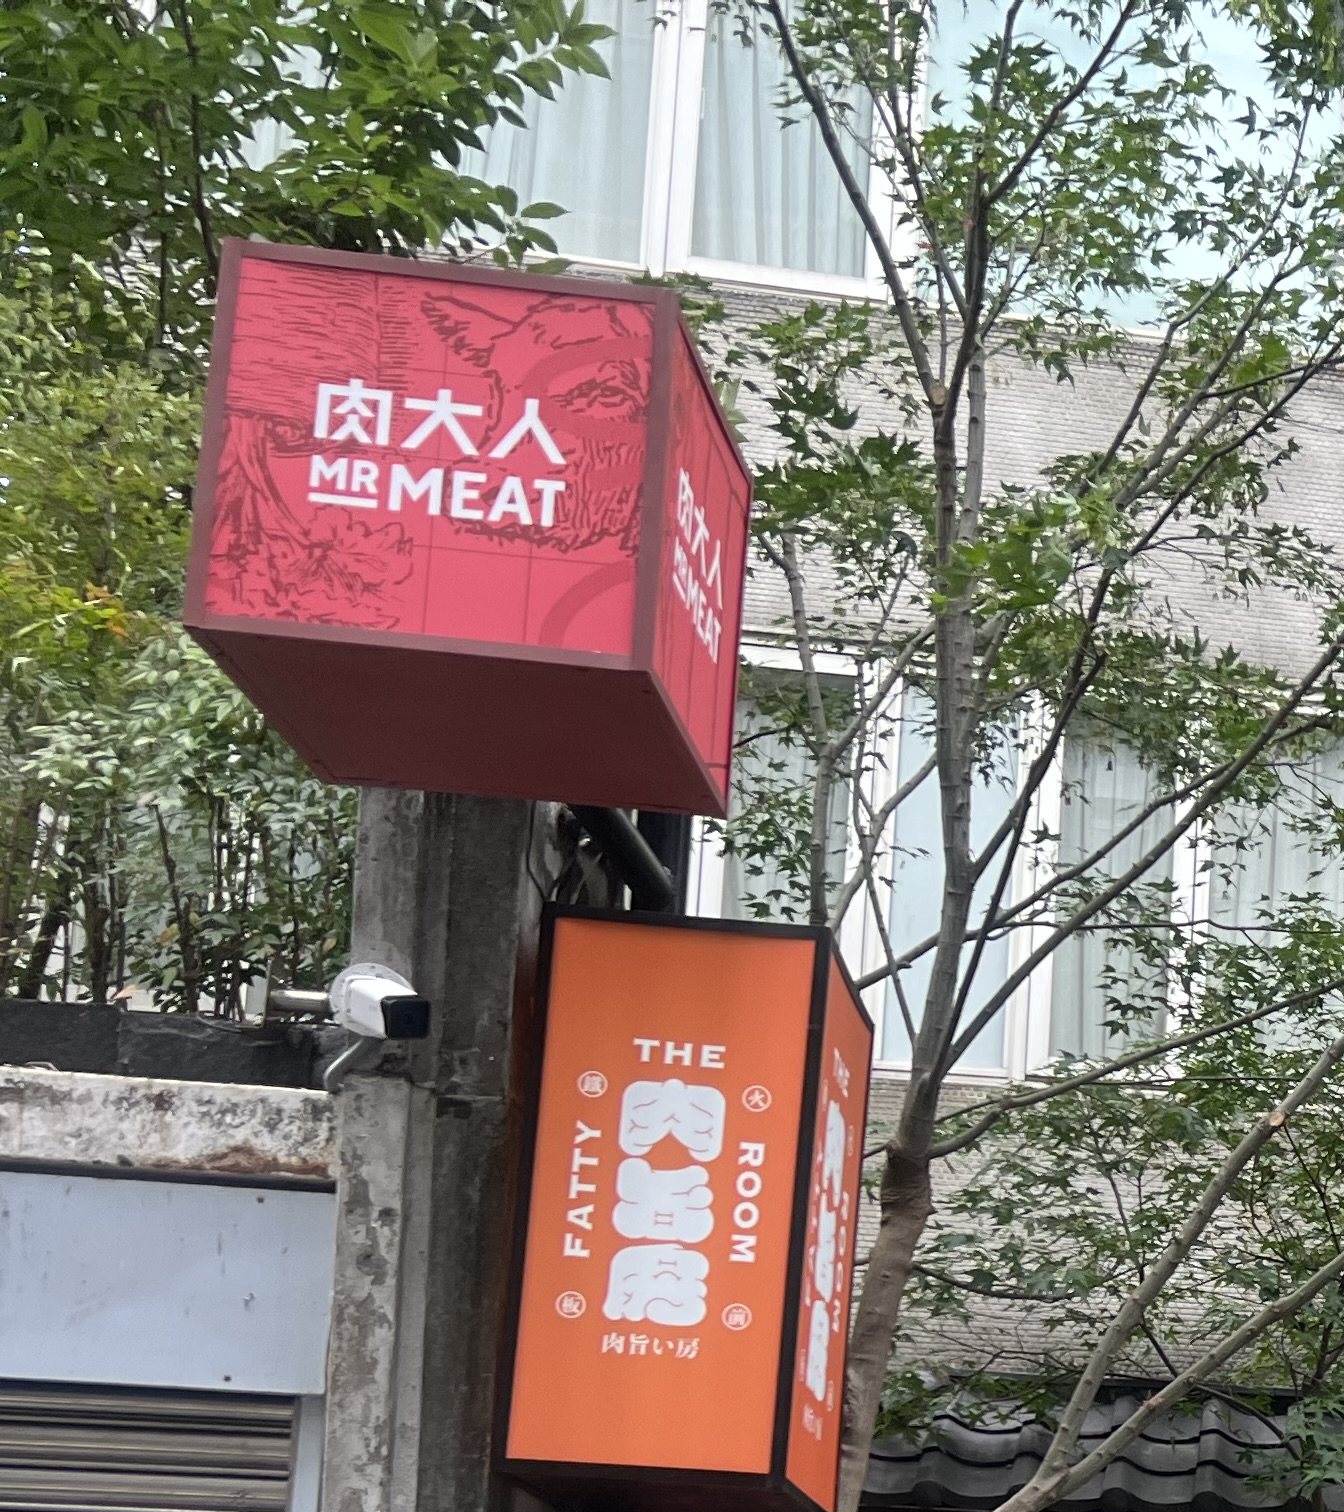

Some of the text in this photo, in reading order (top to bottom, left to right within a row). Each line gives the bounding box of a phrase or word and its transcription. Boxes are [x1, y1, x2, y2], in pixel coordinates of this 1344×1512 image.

[312, 377, 567, 465] 肉大人
[676, 467, 723, 610] 肉大人
[632, 1036, 727, 1070] THE
[563, 1119, 602, 1259] FATTY
[728, 1140, 766, 1264] ROOM
[600, 1331, 700, 1360] 肉旨い房
